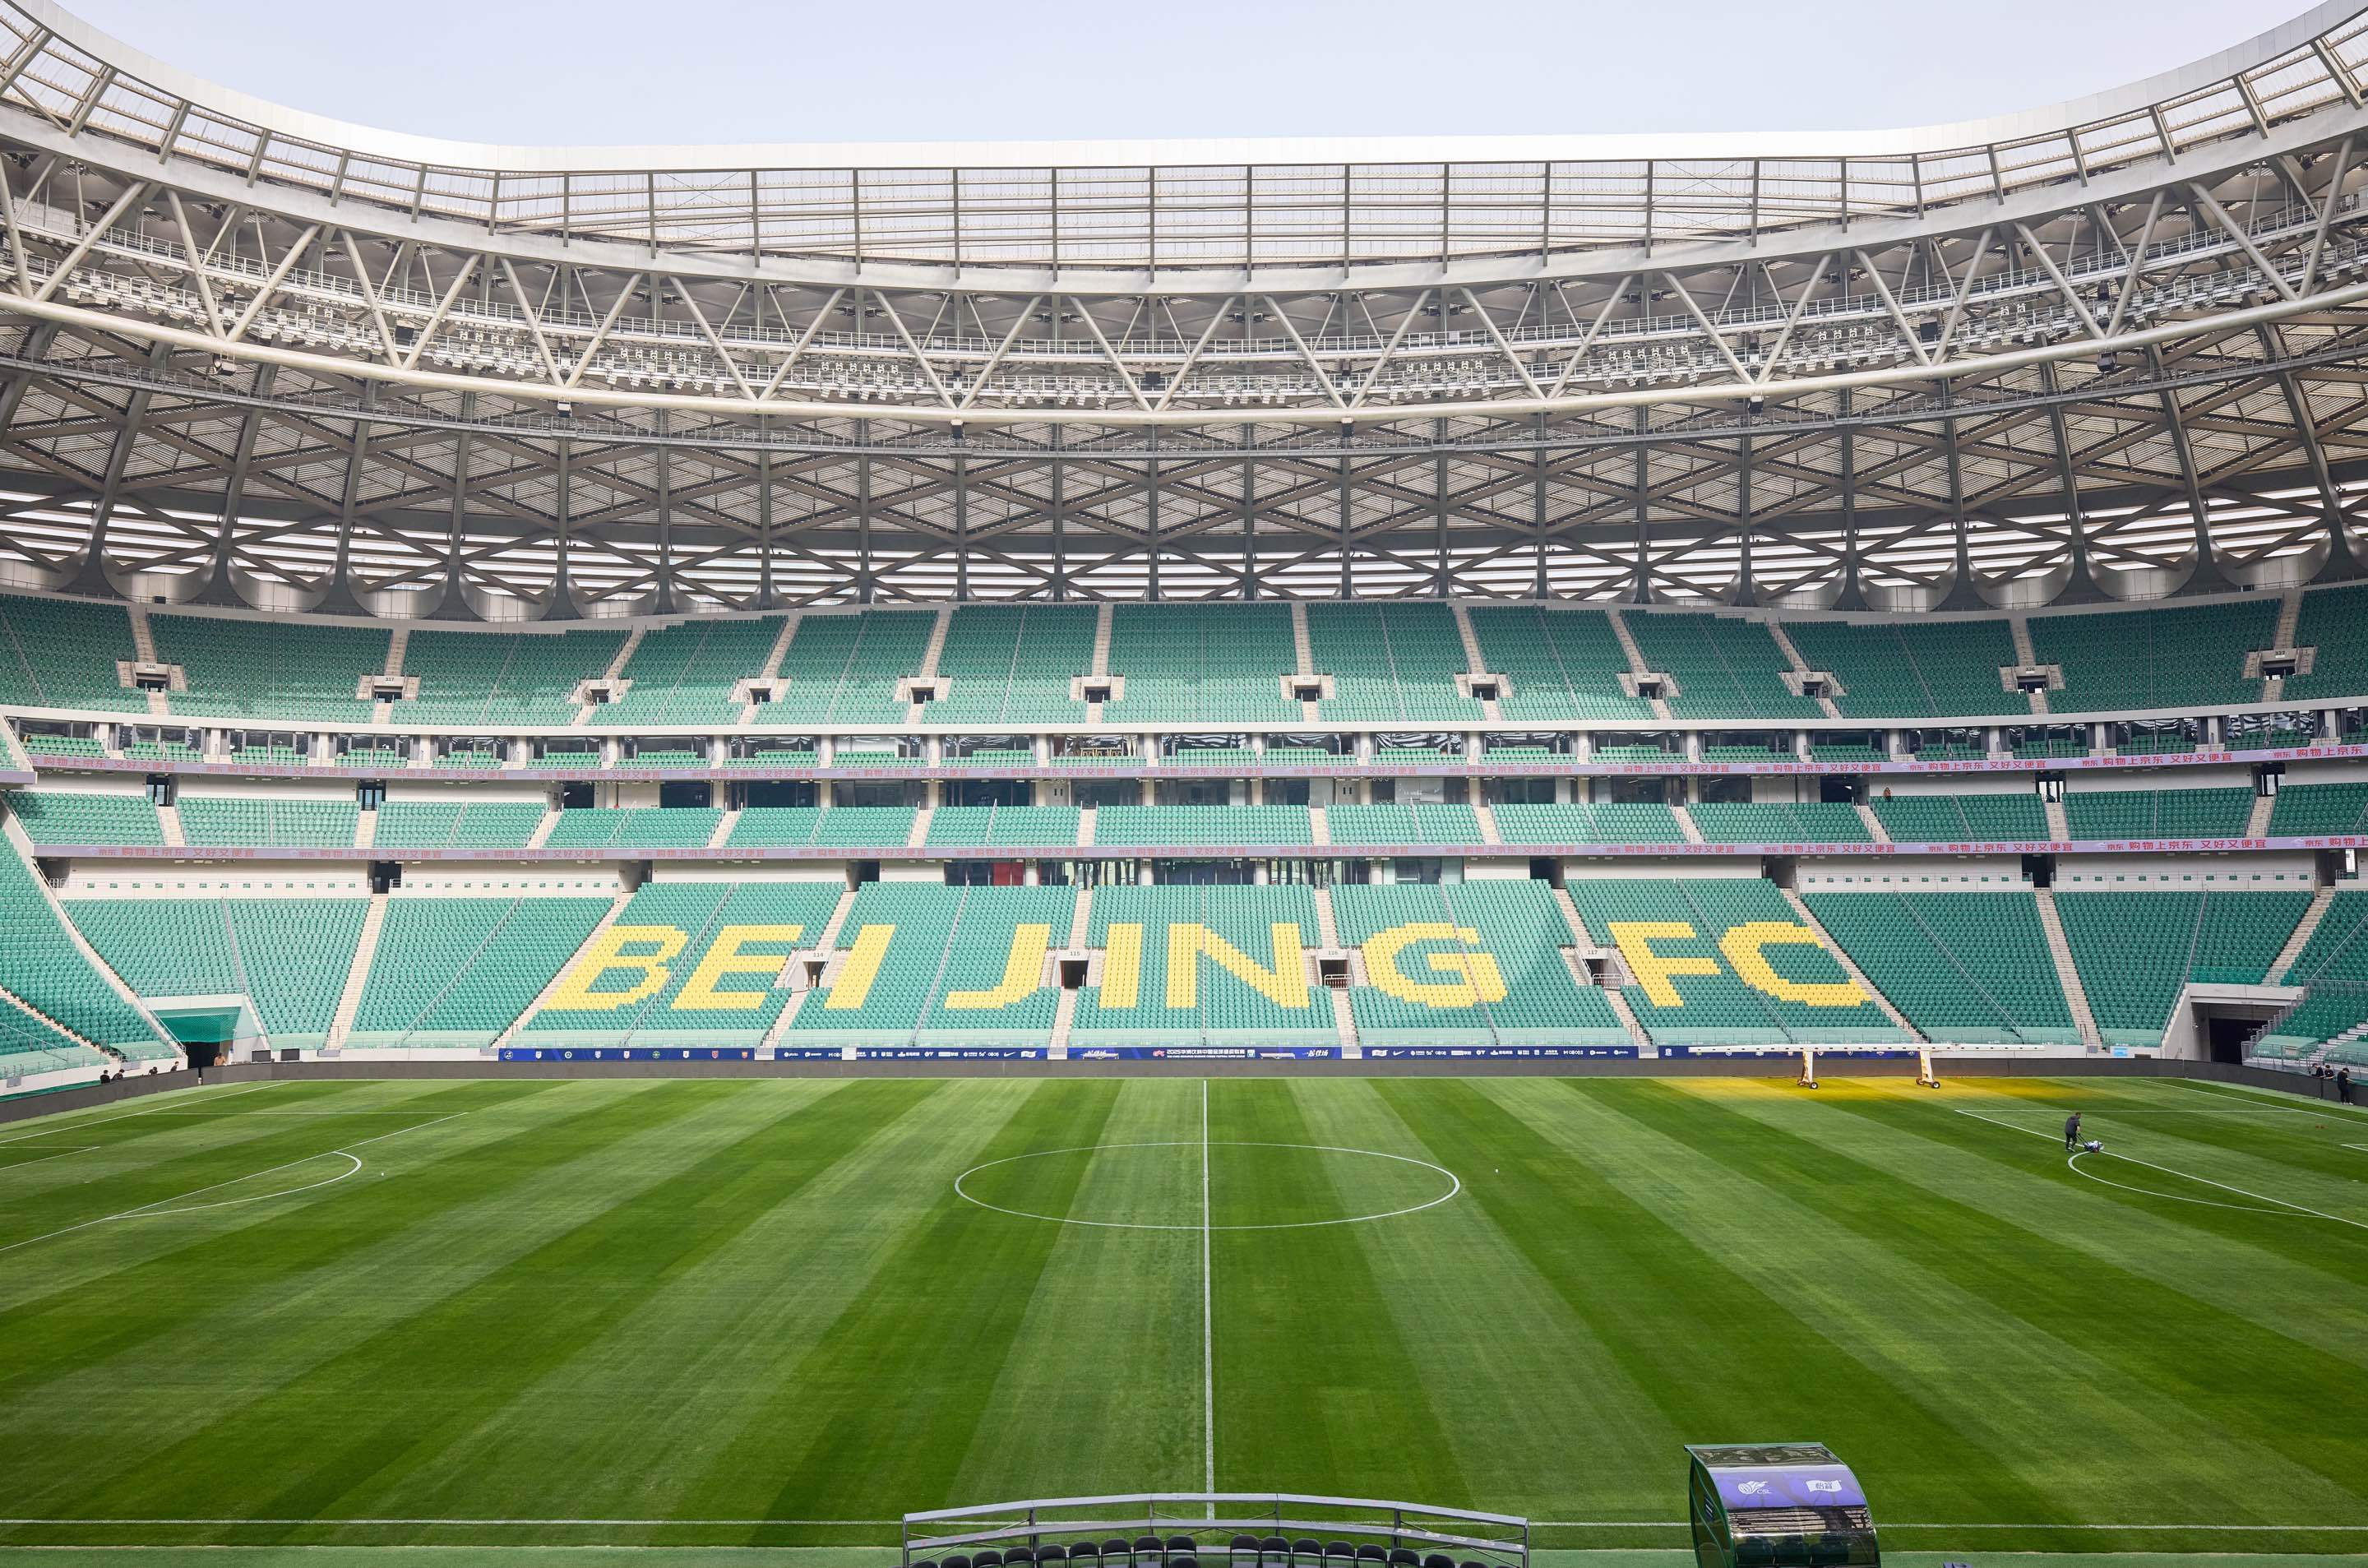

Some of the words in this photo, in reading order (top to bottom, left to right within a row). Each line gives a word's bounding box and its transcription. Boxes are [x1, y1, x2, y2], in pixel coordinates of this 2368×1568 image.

[2296, 746, 2362, 758] 购物上京东
[2102, 756, 2163, 766] 购物上京东
[2171, 752, 2232, 764] 又好又便宜
[1623, 765, 1674, 774] 购物上京东
[1680, 765, 1730, 774] 又好又便宜
[1773, 764, 1824, 773] 购物上京东
[1829, 763, 1881, 772] 又好又便宜
[1928, 761, 1983, 770] 购物上京东
[1990, 760, 2047, 769] 又好又便宜
[1624, 845, 1677, 854] 购物上京东
[1684, 845, 1735, 853] 又好又便宜
[1783, 844, 1836, 853] 购物上京东
[1842, 844, 1895, 853] 又好又便宜
[1948, 843, 2006, 852] 购物上京东
[2013, 842, 2073, 851] 又好又便宜
[2129, 840, 2193, 850] 购物上京东
[2200, 840, 2267, 849] 又好又便宜
[540, 922, 1508, 1011] BEIJING
[1608, 921, 1872, 1008] FC
